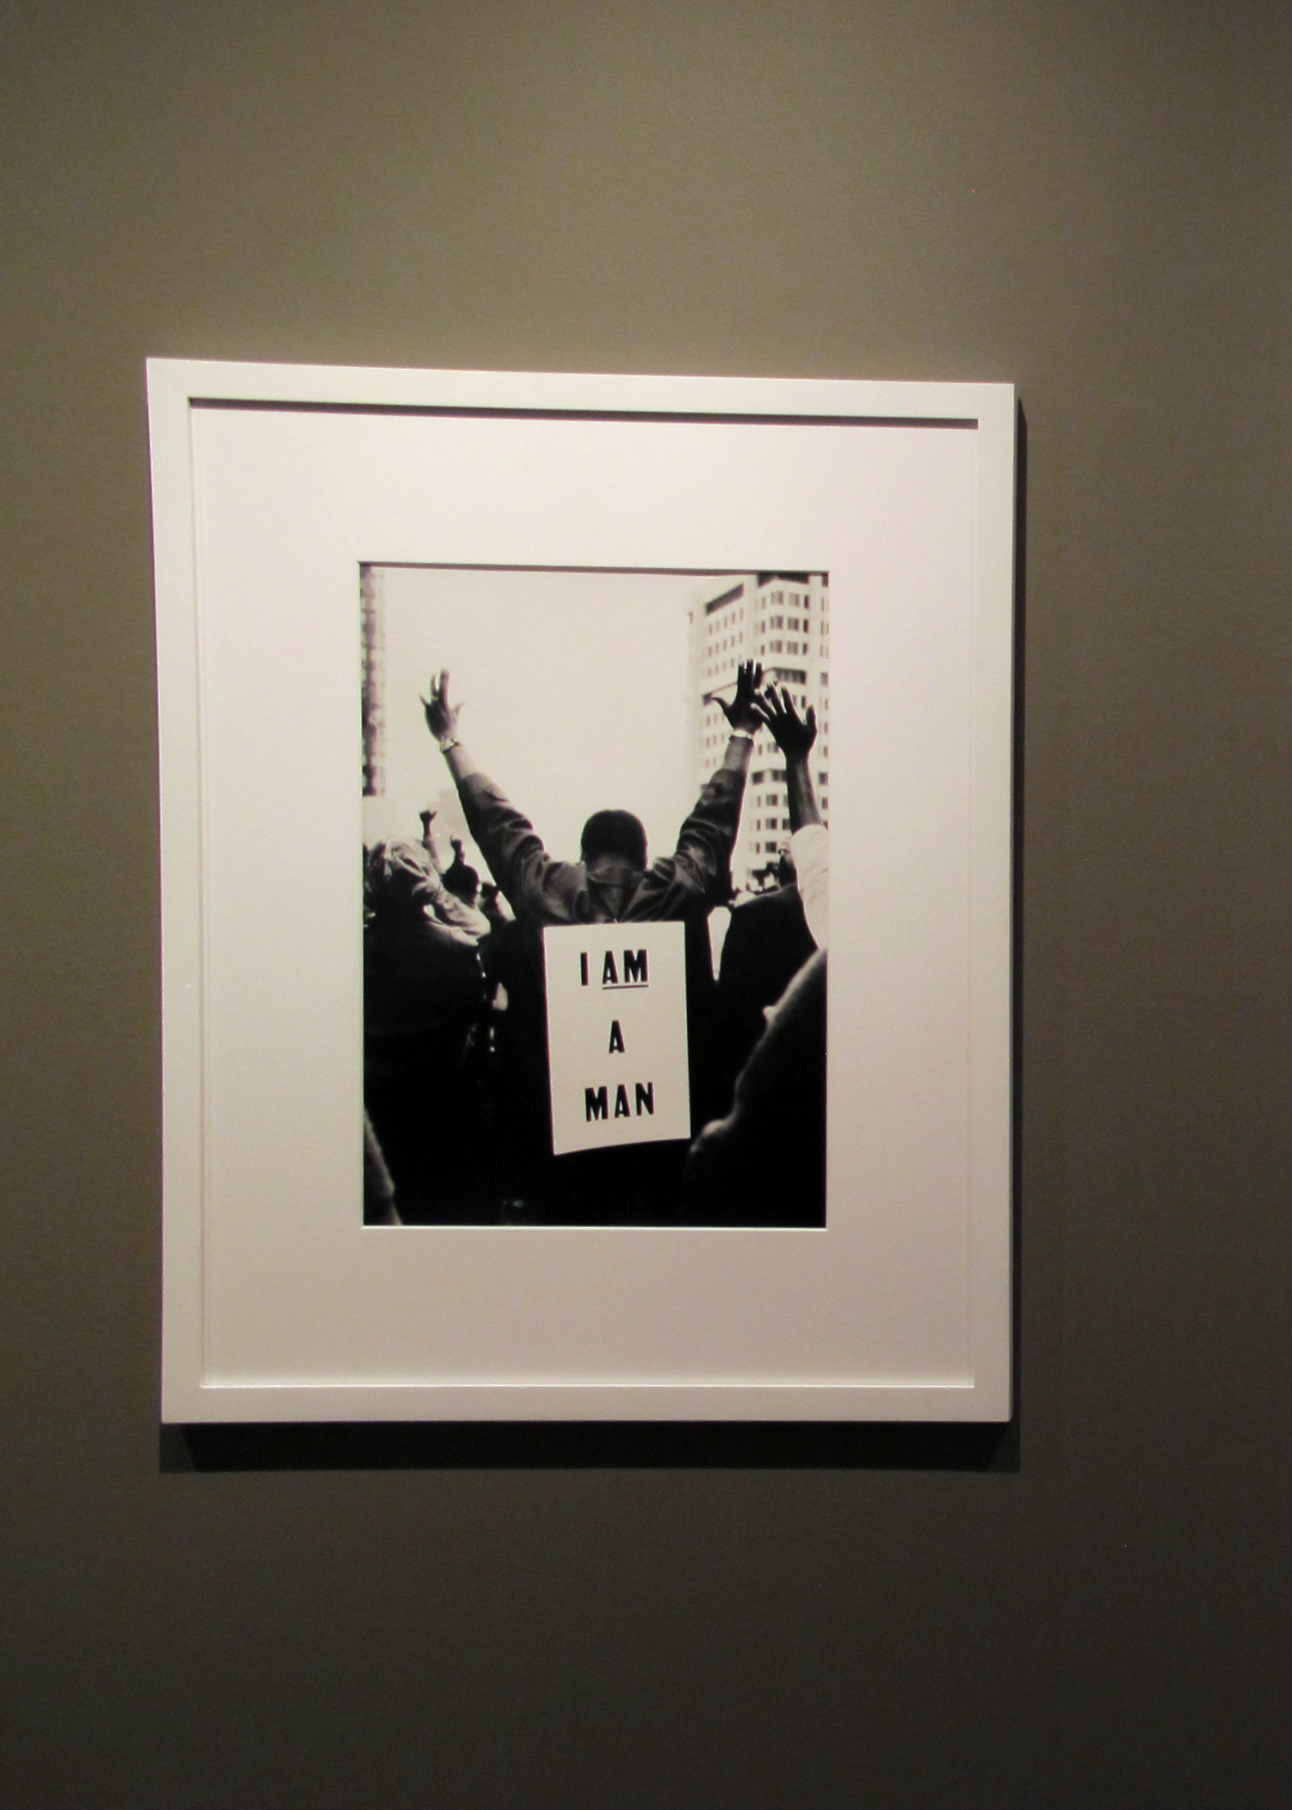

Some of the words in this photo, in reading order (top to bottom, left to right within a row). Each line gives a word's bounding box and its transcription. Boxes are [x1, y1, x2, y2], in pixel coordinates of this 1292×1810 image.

[579, 951, 589, 987] I
[602, 949, 649, 985] AM
[608, 1019, 626, 1054] A
[584, 1081, 655, 1123] MAN
